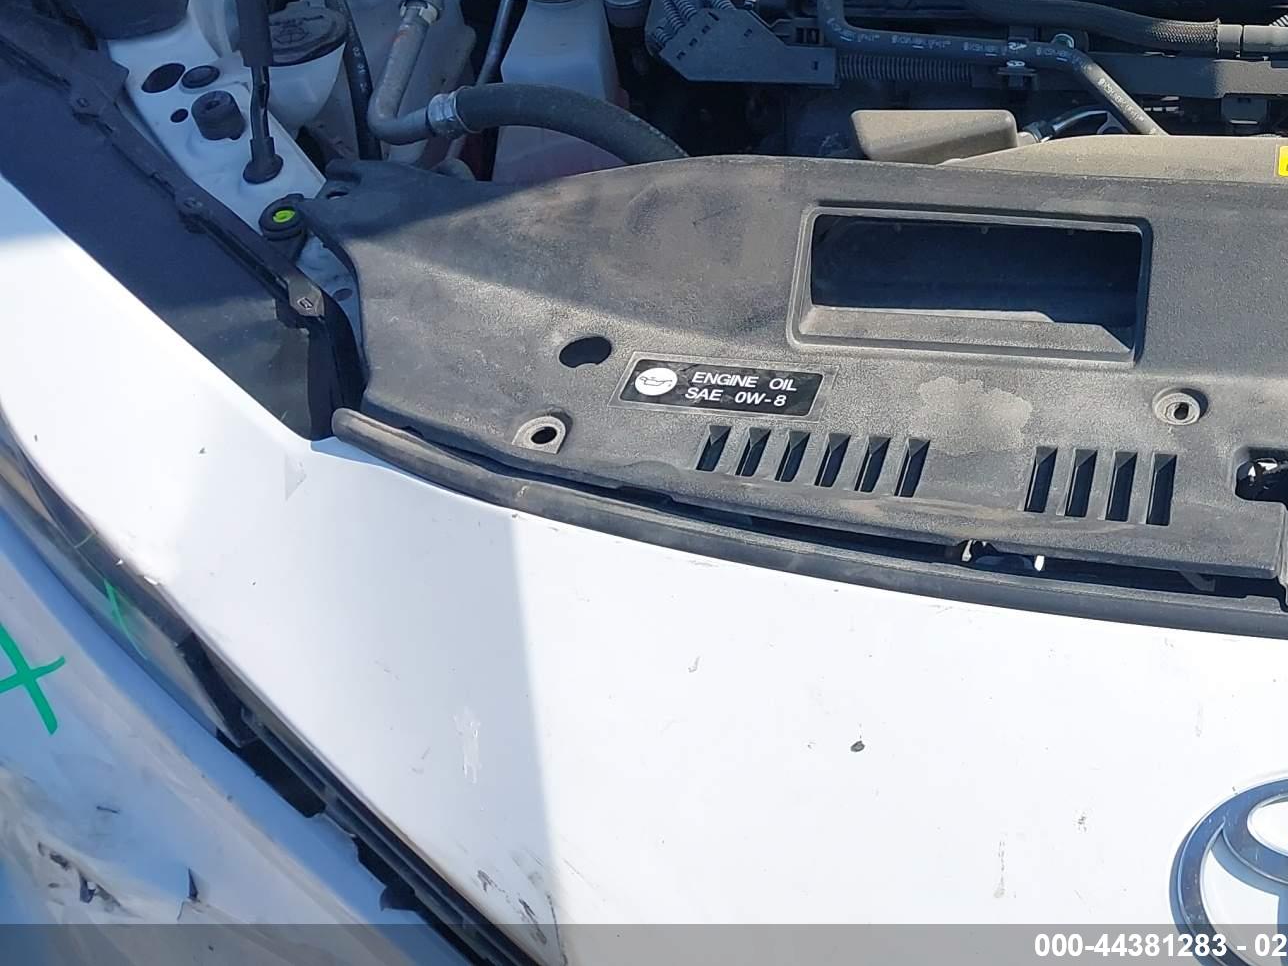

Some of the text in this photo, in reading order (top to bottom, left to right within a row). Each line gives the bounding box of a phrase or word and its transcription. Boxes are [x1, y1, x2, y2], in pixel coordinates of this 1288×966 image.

[691, 371, 798, 392] ENGINE OIL
[685, 386, 787, 407] SAE 0W-8
